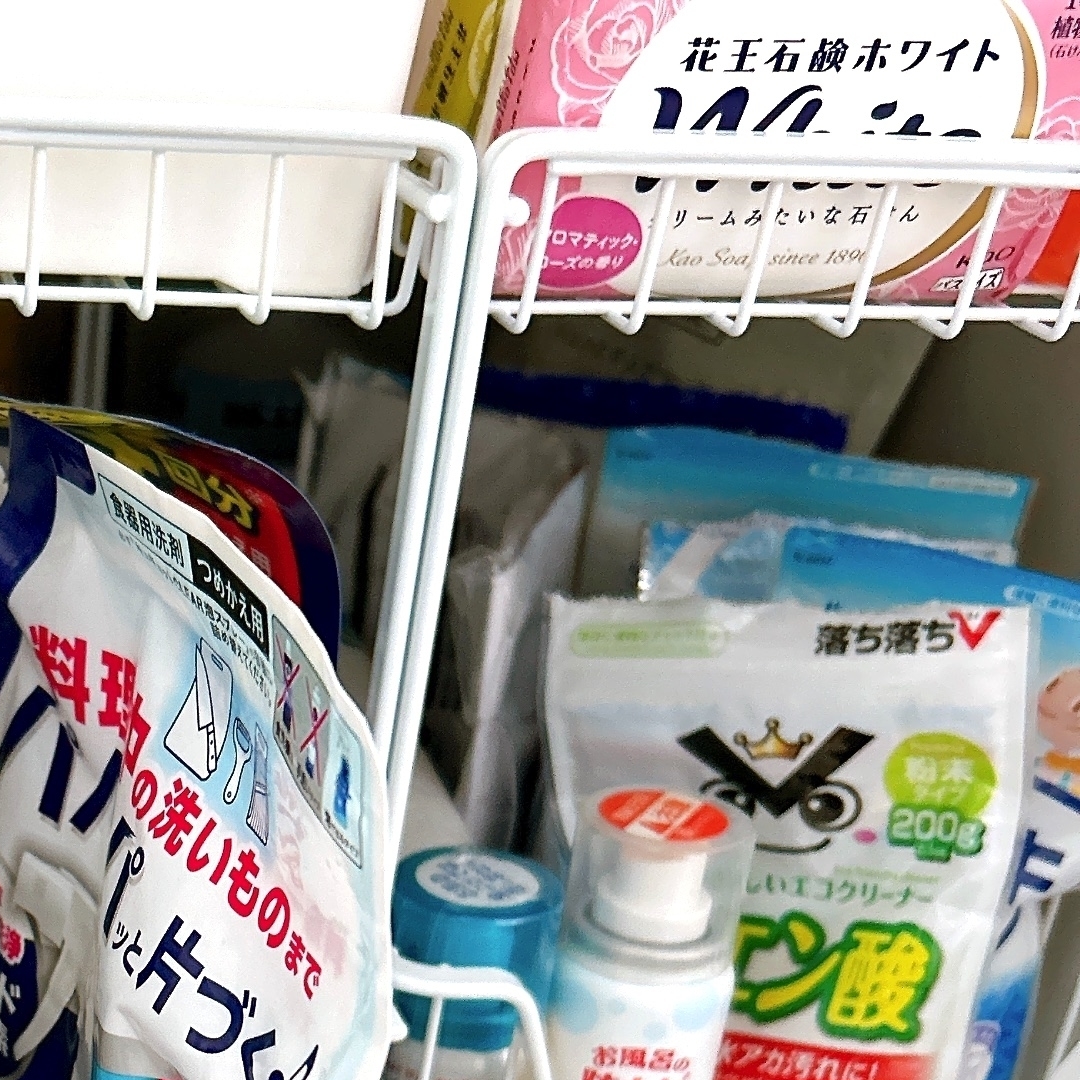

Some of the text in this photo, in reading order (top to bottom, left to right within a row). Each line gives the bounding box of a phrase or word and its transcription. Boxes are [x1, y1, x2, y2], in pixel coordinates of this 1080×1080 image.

[680, 37, 1000, 74] 花王石鹸ホワイト
[649, 205, 919, 228] リームみたいな石ん
[767, 247, 820, 266] since
[934, 269, 1003, 291] バスイズ
[109, 491, 185, 569] 食器用洗剤
[196, 558, 265, 644] つめかえ用
[890, 809, 983, 850] 200g
[591, 1045, 690, 1072] お風呂の
